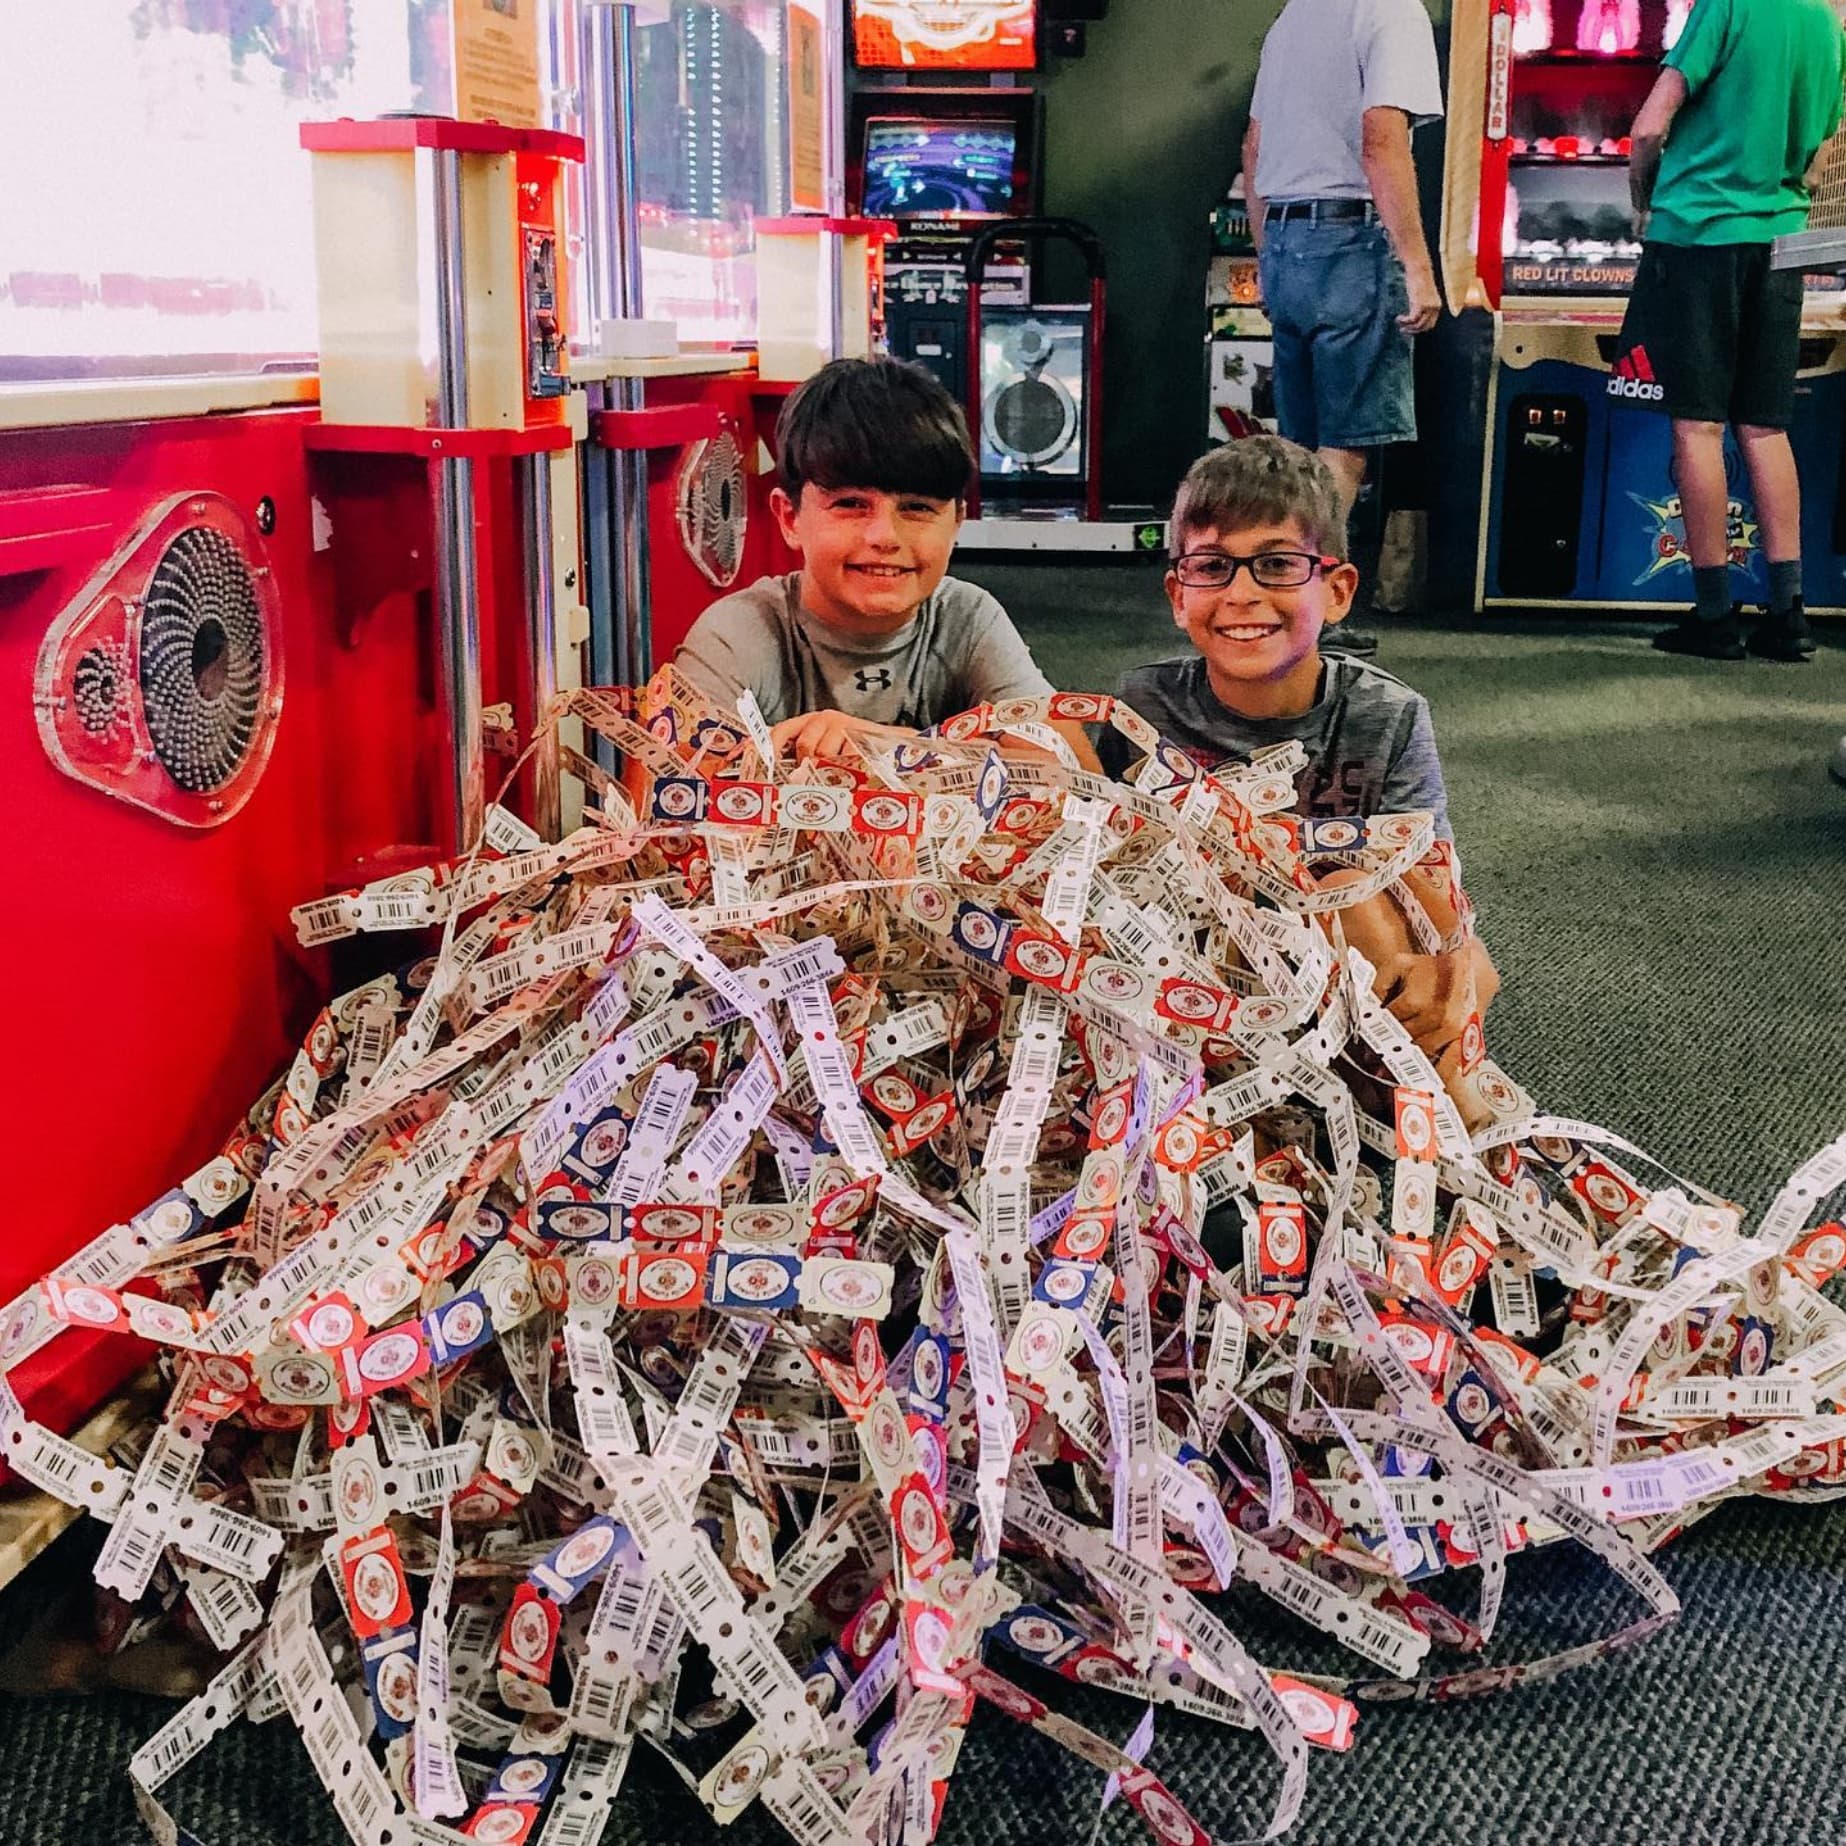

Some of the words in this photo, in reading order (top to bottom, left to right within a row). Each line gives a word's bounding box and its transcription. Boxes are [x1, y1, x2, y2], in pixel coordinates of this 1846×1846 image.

[1492, 44, 1506, 129] DOLLAR
[910, 221, 960, 231] KONAMI
[1512, 265, 1542, 281] RED
[1545, 266, 1569, 282] LIT
[1572, 266, 1635, 284] CLOWNS
[1103, 926, 1147, 968] 1-609-266-3866
[779, 966, 835, 997] 1-609-266-3866
[631, 1073, 663, 1135] 1-609-266-3866
[207, 1505, 273, 1540] 1-609-266-3866
